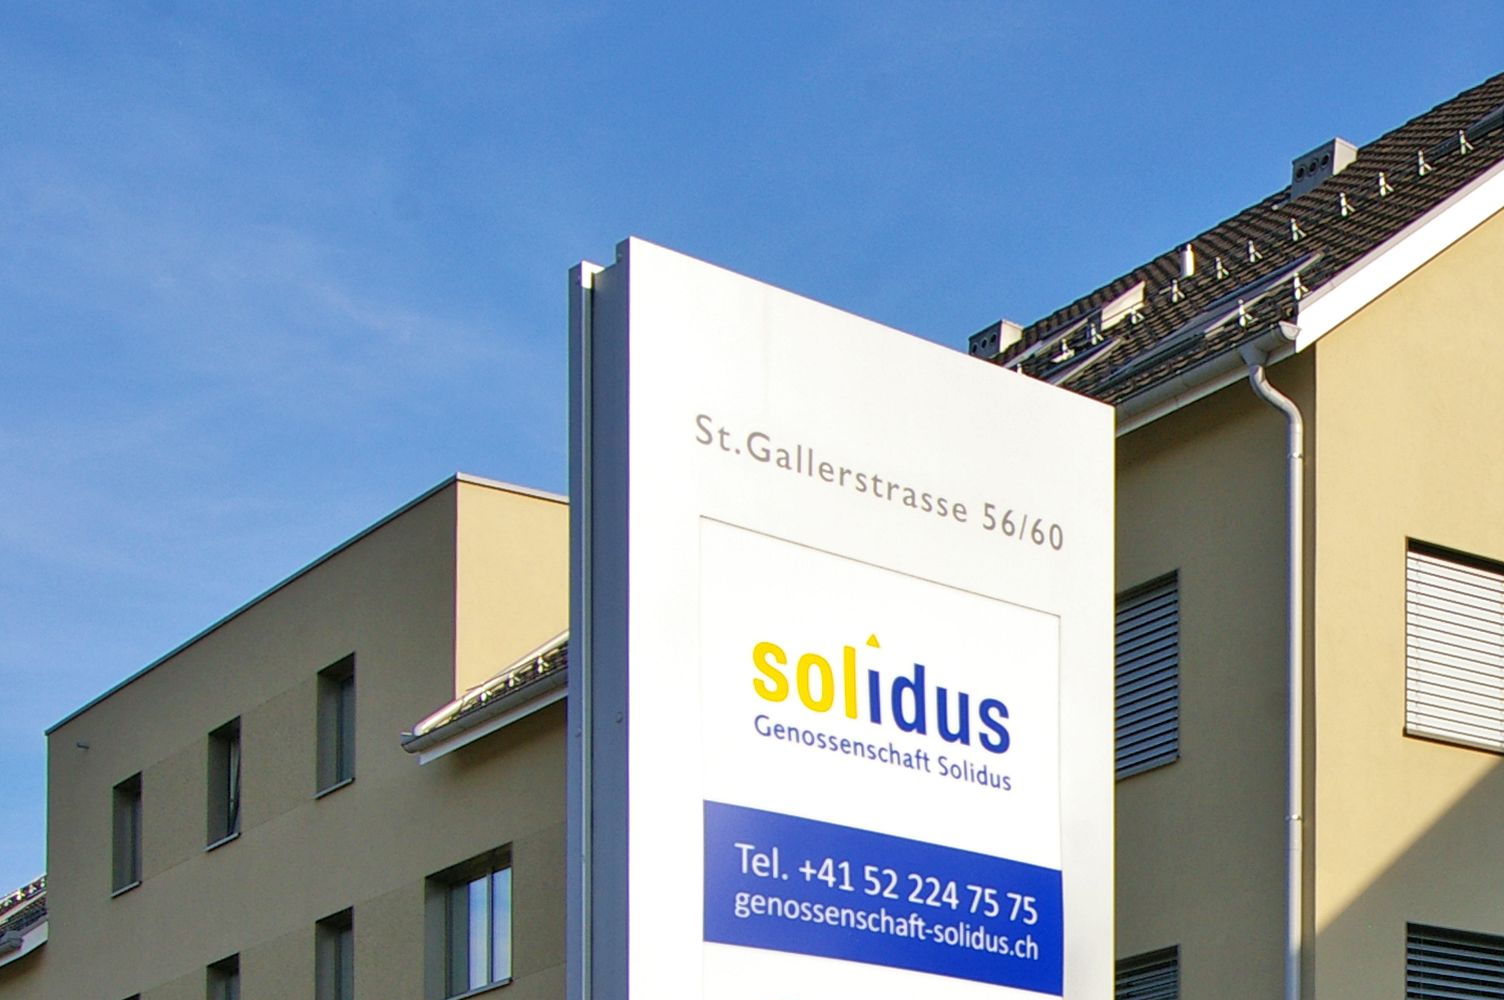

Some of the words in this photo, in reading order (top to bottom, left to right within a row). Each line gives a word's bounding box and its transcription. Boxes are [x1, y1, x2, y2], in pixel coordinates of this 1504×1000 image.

[694, 414, 968, 522] St.Gallerstrasse
[982, 502, 1064, 550] 56/60
[752, 633, 1011, 754] solidus
[753, 714, 931, 774] Genossenschaft
[938, 757, 1012, 791] Solidus
[735, 843, 789, 881] Tel.
[799, 858, 854, 892] +41
[864, 866, 899, 900] 52
[908, 873, 959, 910] 224
[966, 885, 1000, 917] 75
[1006, 892, 1039, 925] 75
[734, 892, 1039, 961] genossenschaft-solidus.ch
